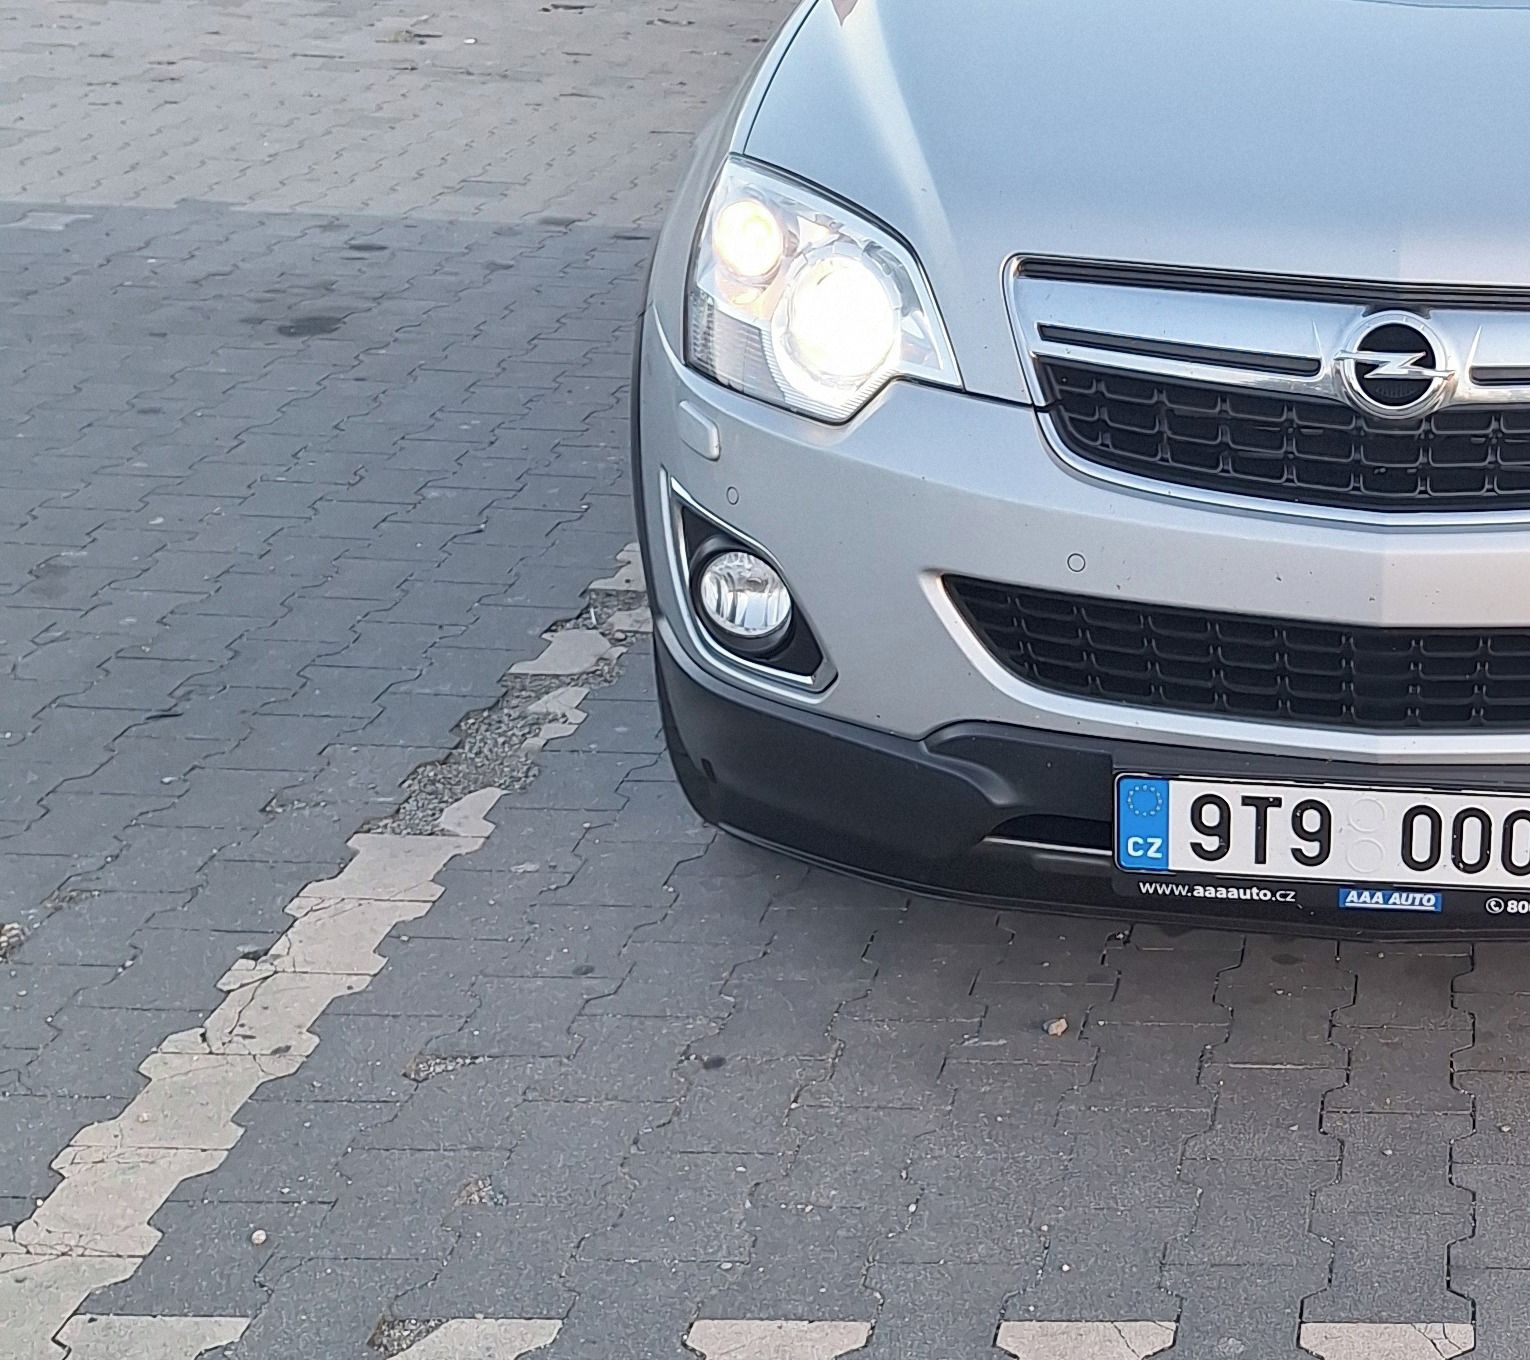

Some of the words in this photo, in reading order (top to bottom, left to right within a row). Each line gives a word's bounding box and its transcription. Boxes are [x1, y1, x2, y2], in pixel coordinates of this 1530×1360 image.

[1190, 793, 1332, 867] 9T9
[1127, 836, 1163, 858] CZ
[1139, 881, 1296, 902] www.aaaauto.cz
[1346, 890, 1384, 905] AAA
[1388, 892, 1436, 907] AUTO
